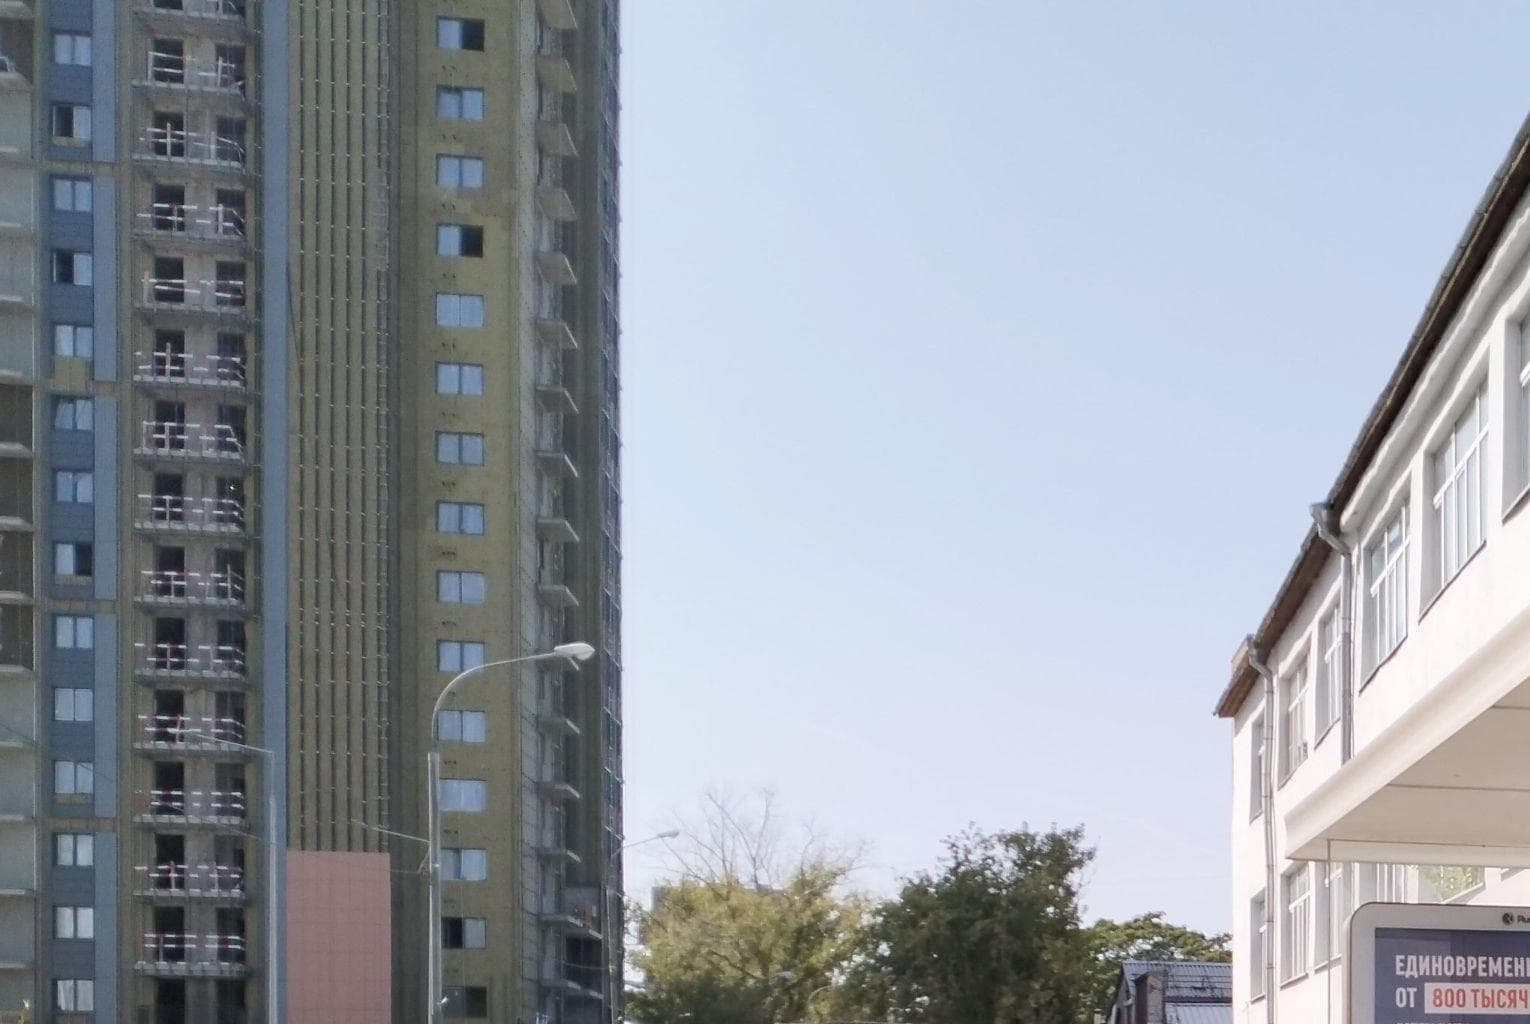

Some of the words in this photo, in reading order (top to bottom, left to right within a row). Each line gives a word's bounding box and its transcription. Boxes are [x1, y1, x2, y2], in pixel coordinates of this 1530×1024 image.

[1395, 987, 1417, 1009] ОТ
[1432, 988, 1465, 1009] 800
[1471, 988, 1529, 1010] ТЫСЯЧ
